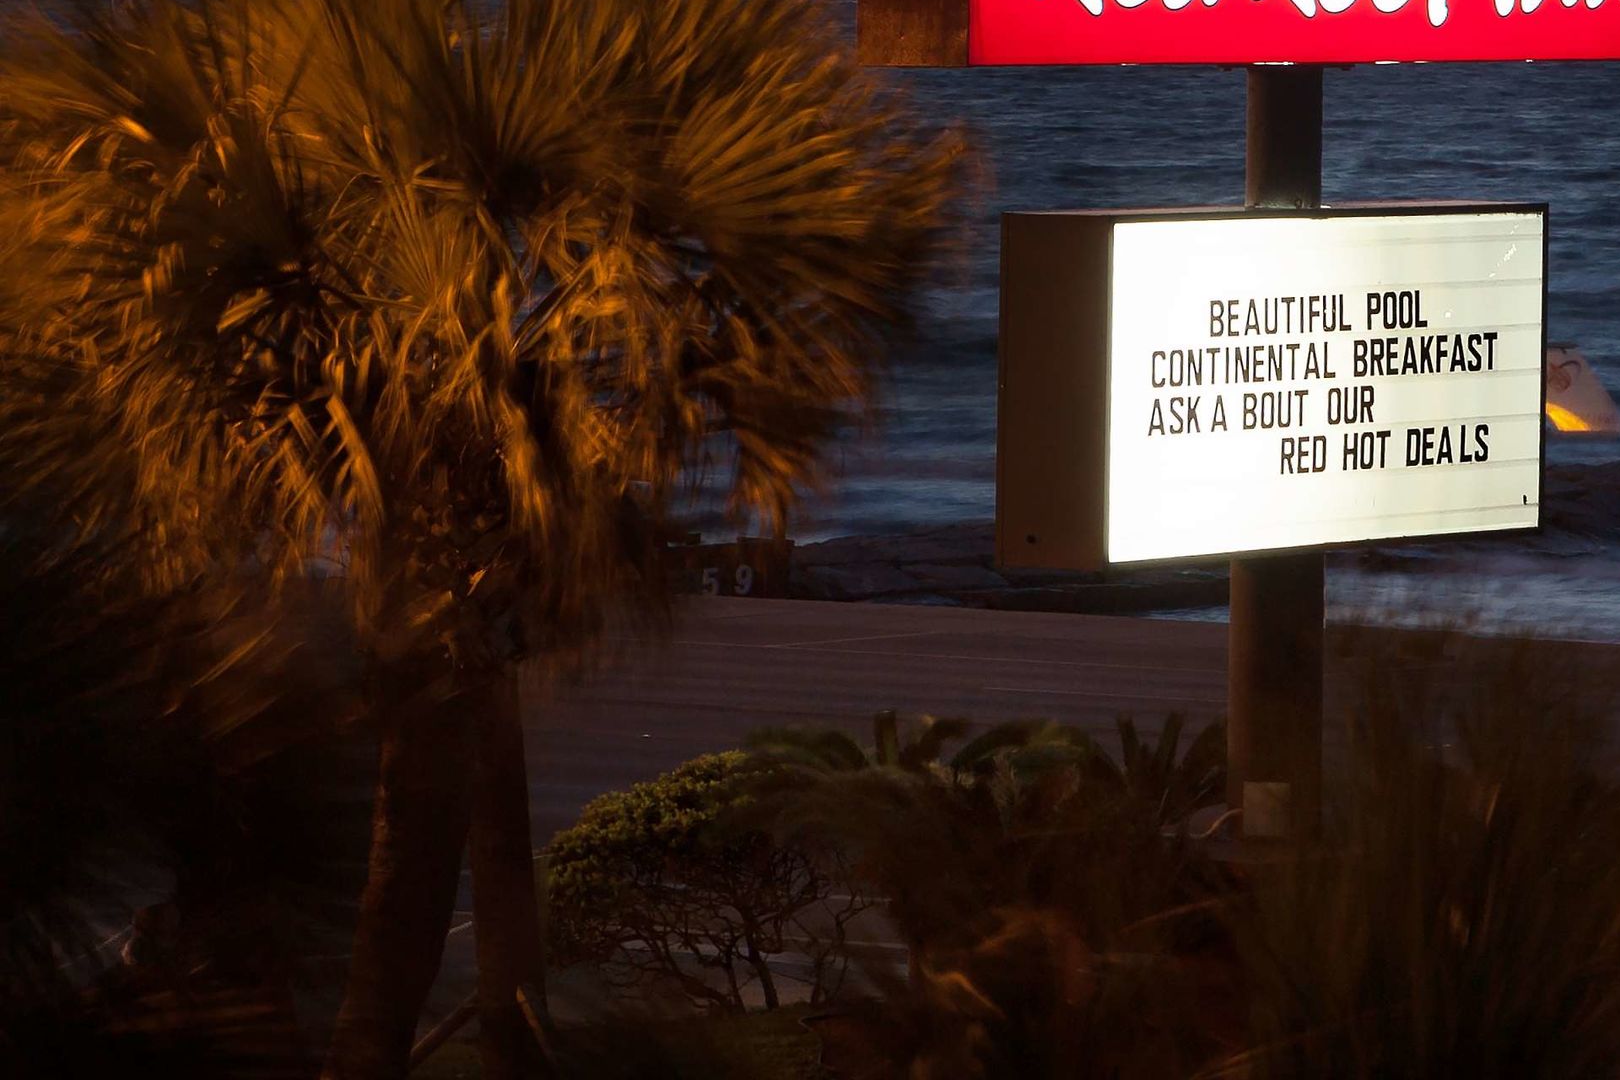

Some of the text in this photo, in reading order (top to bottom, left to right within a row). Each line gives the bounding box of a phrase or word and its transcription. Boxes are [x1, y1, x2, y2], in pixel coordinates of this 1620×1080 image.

[1210, 289, 1428, 338] BEAUTIFUL POOL
[1151, 331, 1499, 389] CONTINENTAL BREAKFAST
[1147, 396, 1201, 437] ASK
[1327, 385, 1375, 426] OUR
[1280, 423, 1490, 475] RED HOT DEALS
